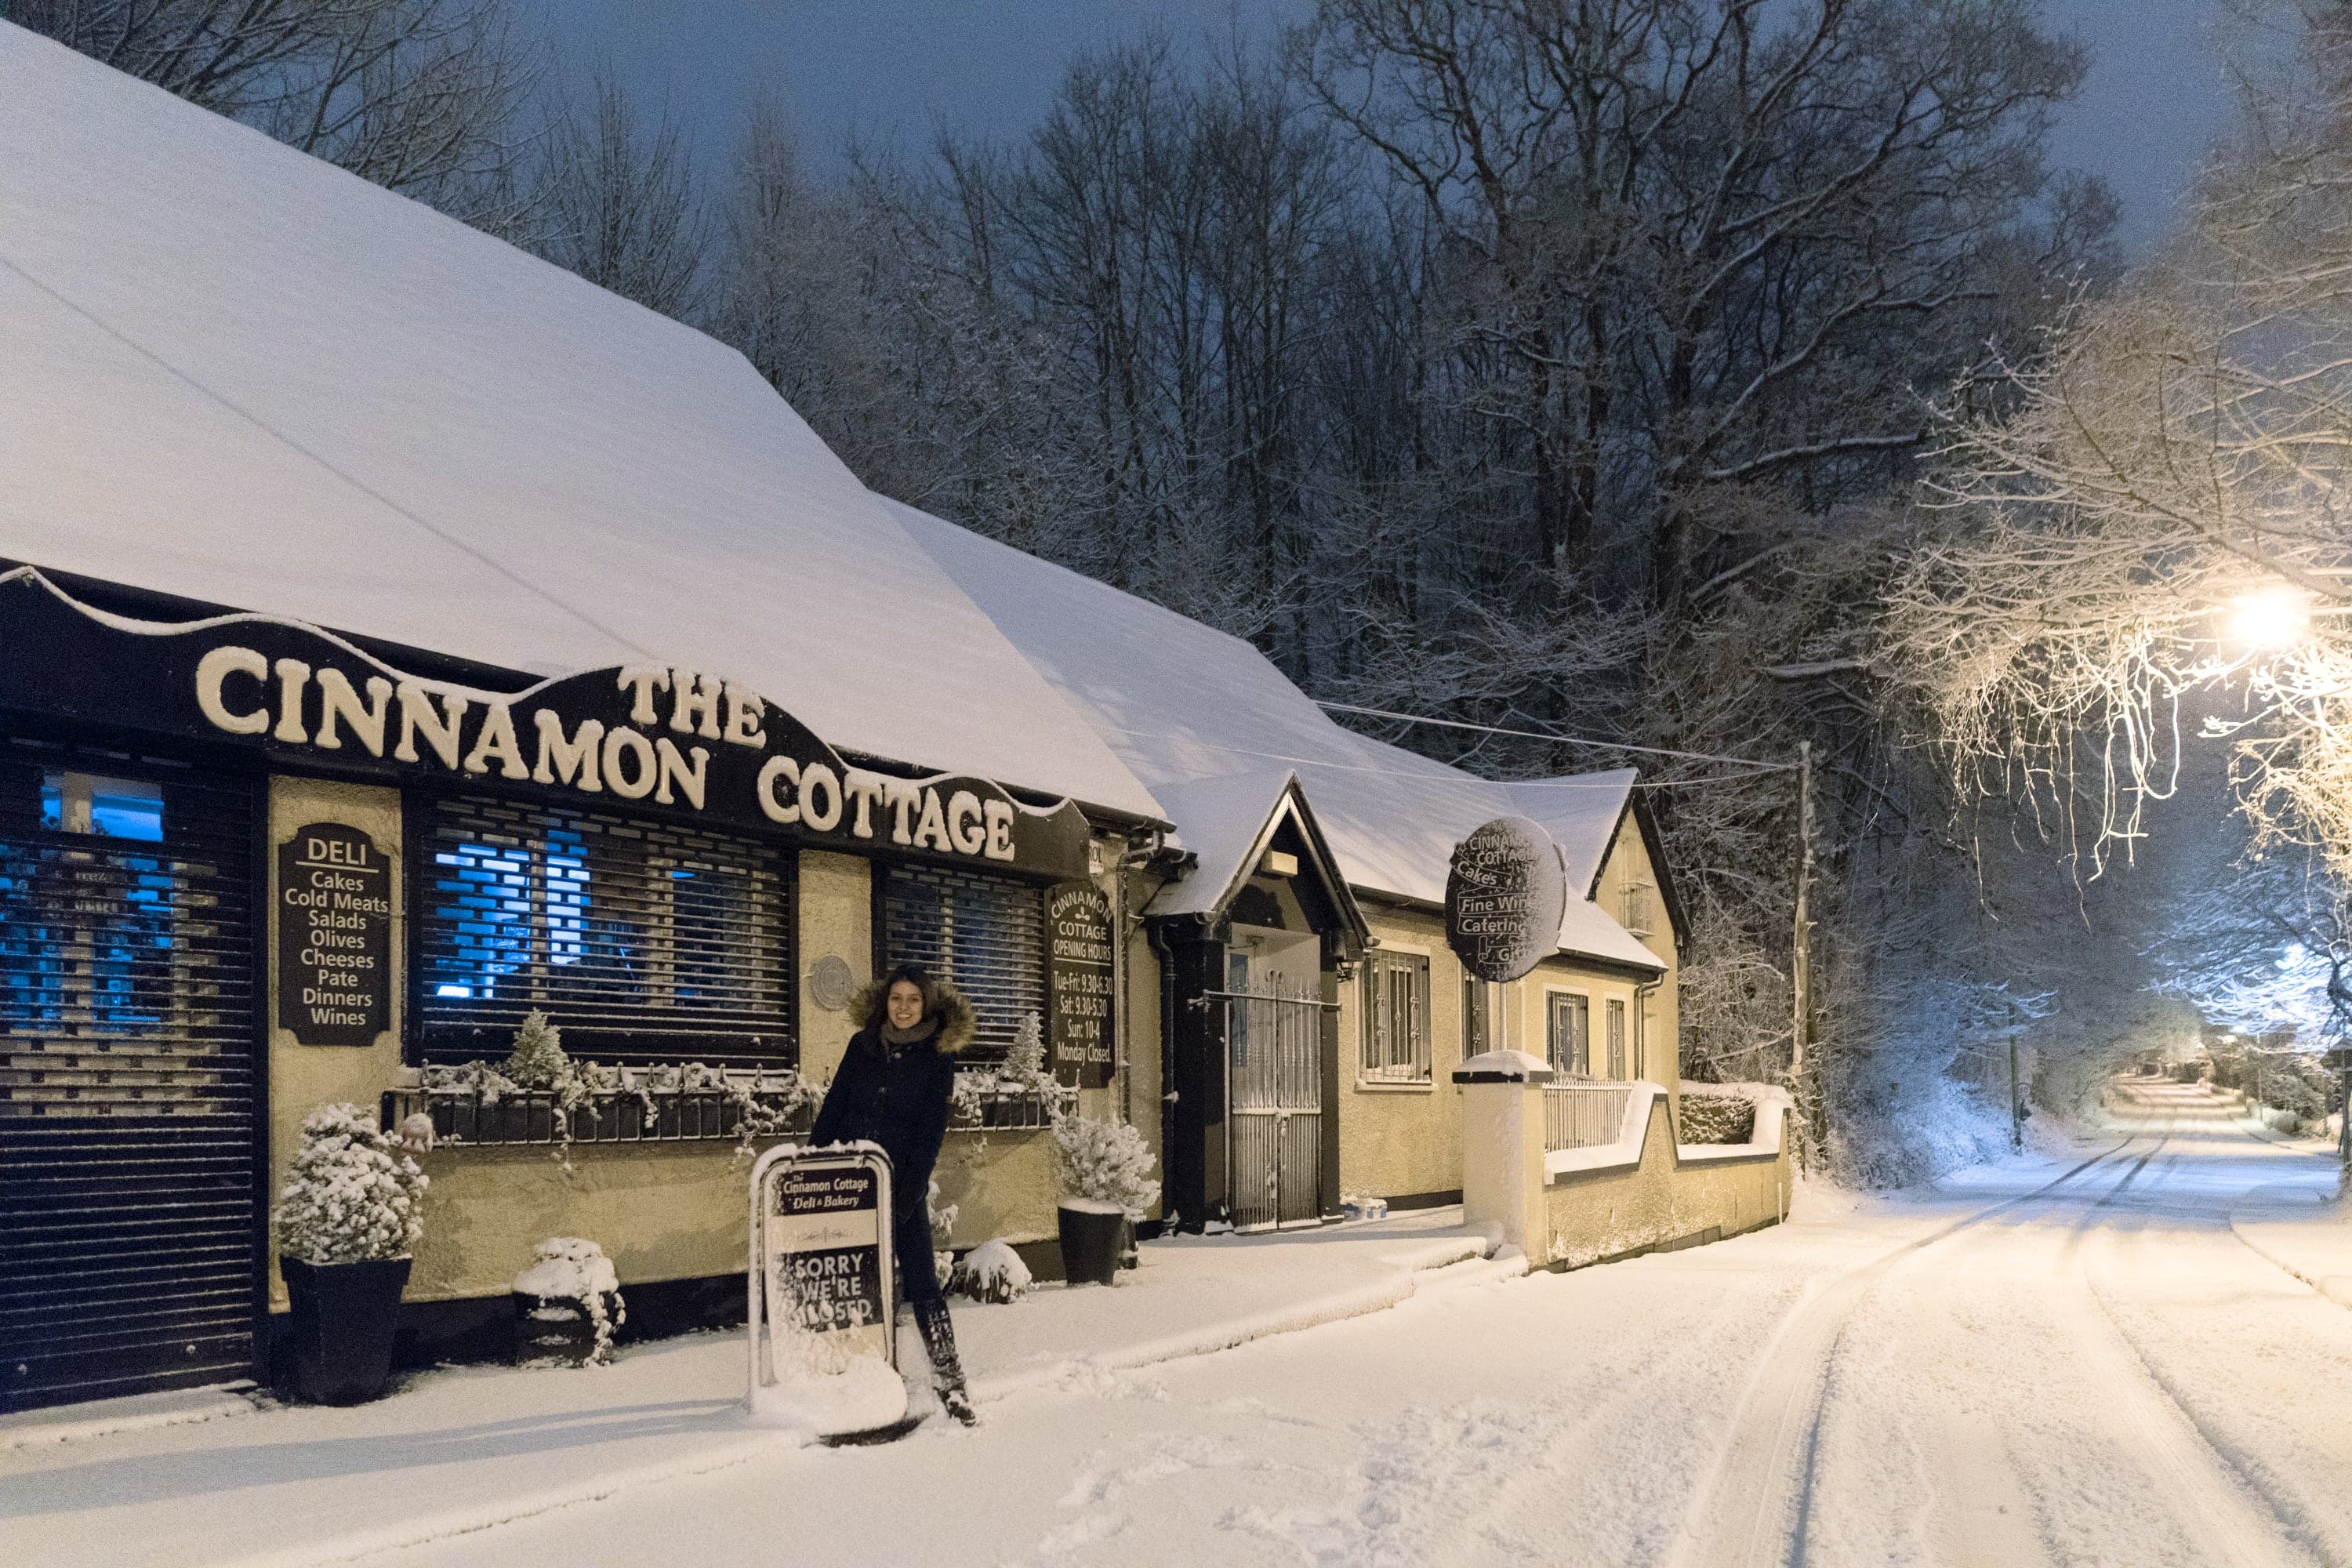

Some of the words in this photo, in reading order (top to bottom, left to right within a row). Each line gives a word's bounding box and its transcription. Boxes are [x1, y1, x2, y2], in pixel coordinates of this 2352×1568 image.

[618, 662, 766, 748] THE
[196, 647, 710, 809] CINNAMON
[758, 755, 1015, 861] COTTAGE
[307, 837, 366, 866] DELI
[310, 871, 364, 891] Cakes
[1457, 861, 1497, 885] Cakes
[285, 888, 328, 907] Cold
[334, 893, 388, 913] Meats
[1051, 891, 1112, 923] CINNAMON
[1461, 898, 1494, 912] Fine
[309, 909, 367, 930] Salads
[310, 930, 365, 949] Olives
[1059, 921, 1106, 941] COTTAGE
[301, 949, 375, 969] Cheeses
[1054, 939, 1086, 957] OPENING
[1088, 943, 1111, 960] HOURS
[318, 969, 358, 986] Pate
[1054, 971, 1080, 992] Tue-Fri:
[1082, 975, 1113, 995] 9.30-6.30
[303, 988, 372, 1007] Dinners
[1060, 995, 1074, 1014] Sat:
[1076, 998, 1107, 1017] 9.30-5.30
[310, 1007, 365, 1025] Wines
[1068, 1019, 1083, 1037] Sun:
[1085, 1022, 1100, 1039] 10-4
[1058, 1042, 1086, 1065] Monday
[783, 1181, 830, 1194] Cinnamon
[833, 1178, 869, 1192] Cottage
[793, 1196, 815, 1209] Deli
[823, 1195, 859, 1207] Bakery
[795, 1253, 863, 1279] SORRY
[802, 1276, 861, 1300] WE'RE
